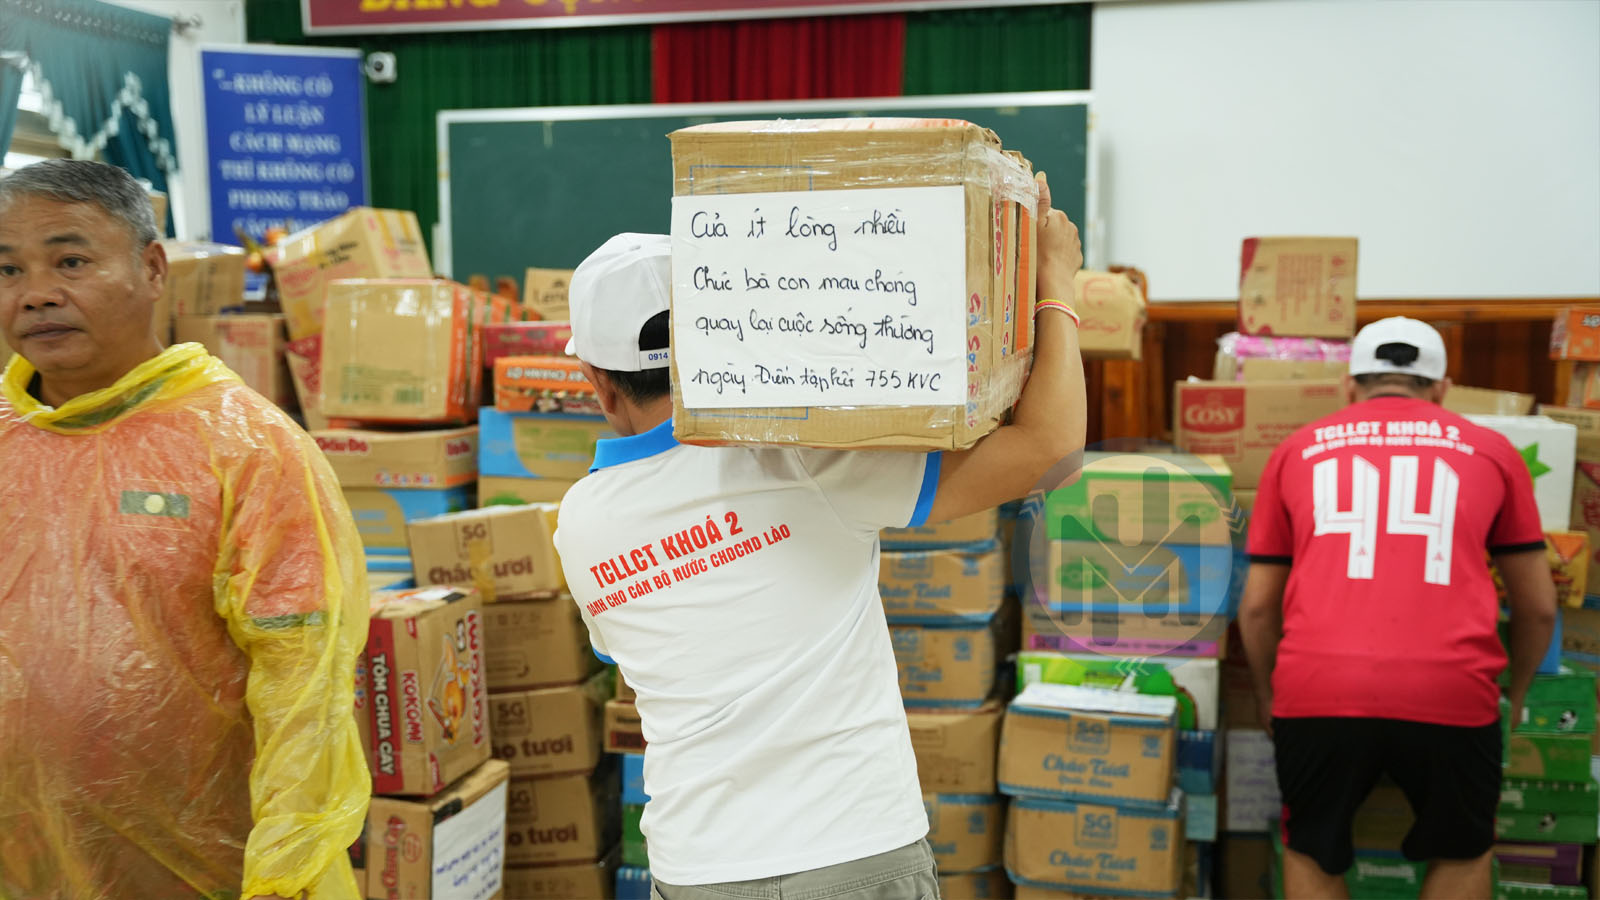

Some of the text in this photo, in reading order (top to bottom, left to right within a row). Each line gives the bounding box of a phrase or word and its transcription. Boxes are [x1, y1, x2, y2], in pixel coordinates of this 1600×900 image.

[785, 206, 837, 251] lòng
[854, 208, 906, 236] nhiều
[777, 277, 810, 290] con
[818, 276, 860, 290] mau
[695, 316, 744, 341] quay
[750, 308, 774, 335] lại
[778, 312, 814, 336] cuộc
[819, 307, 867, 348] sống
[648, 352, 668, 361] 0914
[691, 362, 746, 394] ngày
[865, 370, 902, 388] 755
[907, 372, 942, 391] KVC
[1185, 404, 1240, 424] COSY
[1386, 419, 1443, 437] KHOÁ
[1446, 425, 1460, 441] 2
[590, 511, 743, 588] TCLLCT KHOÁ 2
[605, 589, 627, 608] CHO
[652, 569, 672, 589] BỘ
[672, 558, 708, 582] NƯỚC
[709, 536, 762, 568] CHDCND
[763, 523, 791, 546] LÀO
[372, 653, 395, 775] TÔM CHUA CAY
[403, 671, 424, 744] KOKOMI
